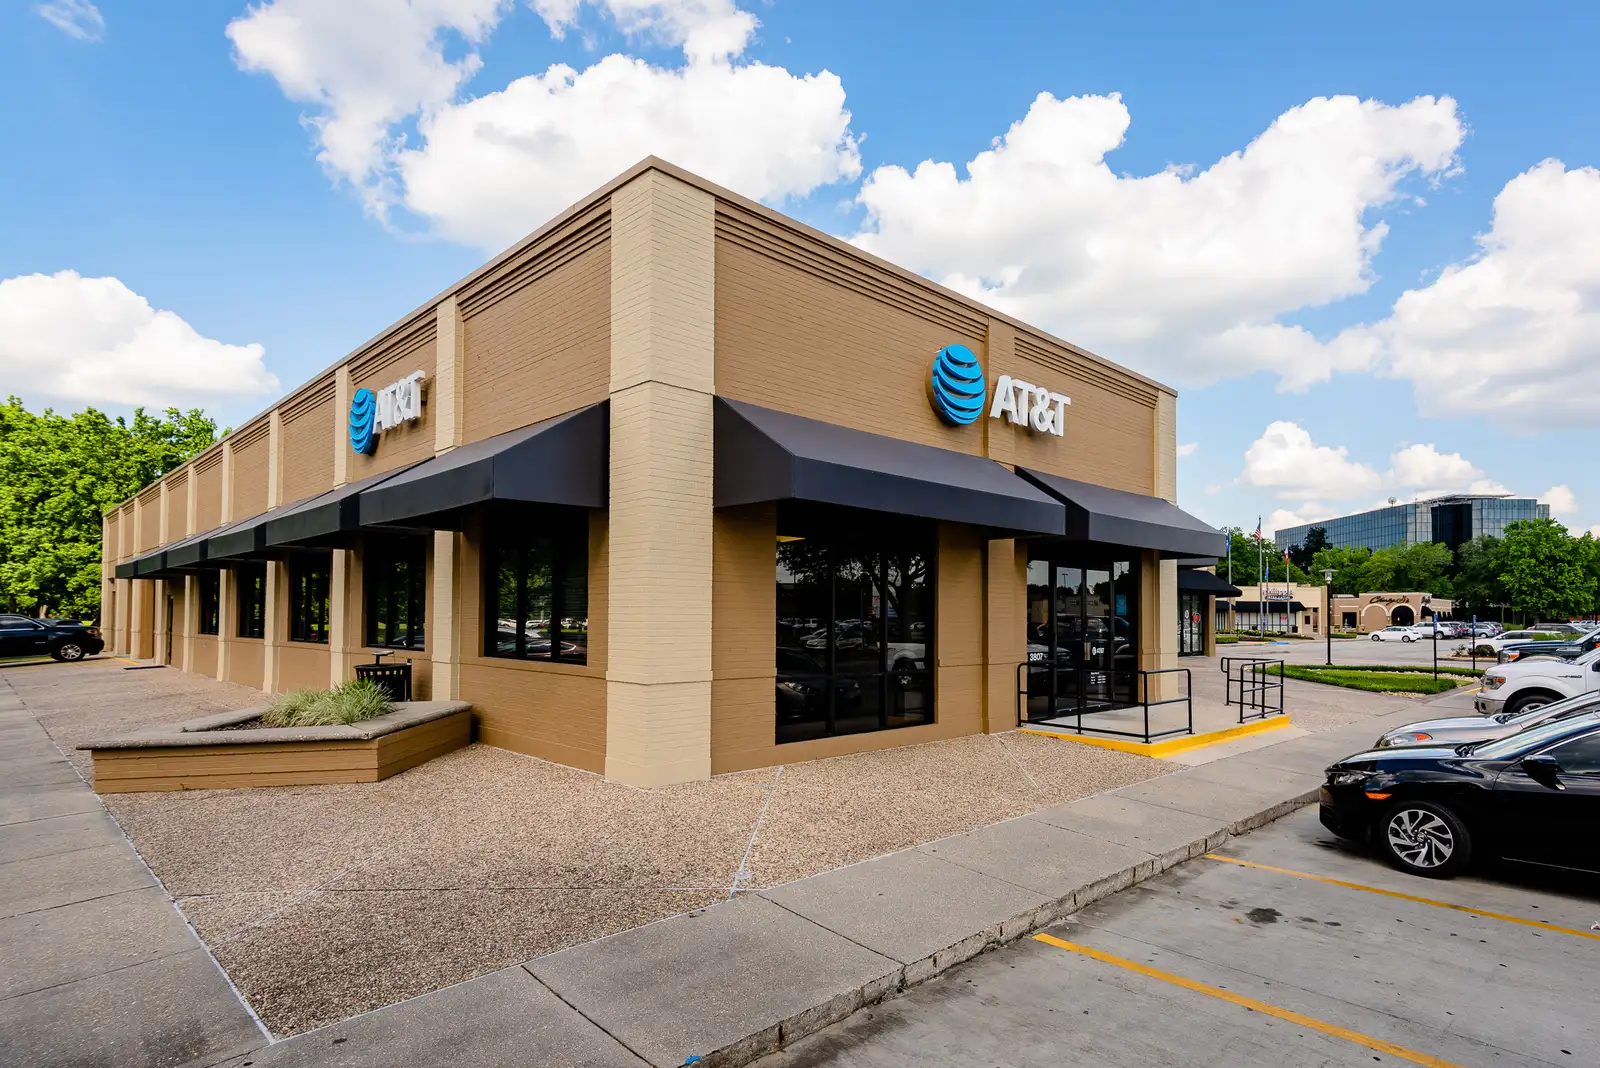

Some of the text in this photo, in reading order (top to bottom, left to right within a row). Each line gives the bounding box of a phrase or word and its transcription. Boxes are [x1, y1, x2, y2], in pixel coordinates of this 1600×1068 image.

[373, 370, 426, 434] AT&T
[990, 375, 1071, 437] AT&T
[1030, 652, 1043, 661] 3807
